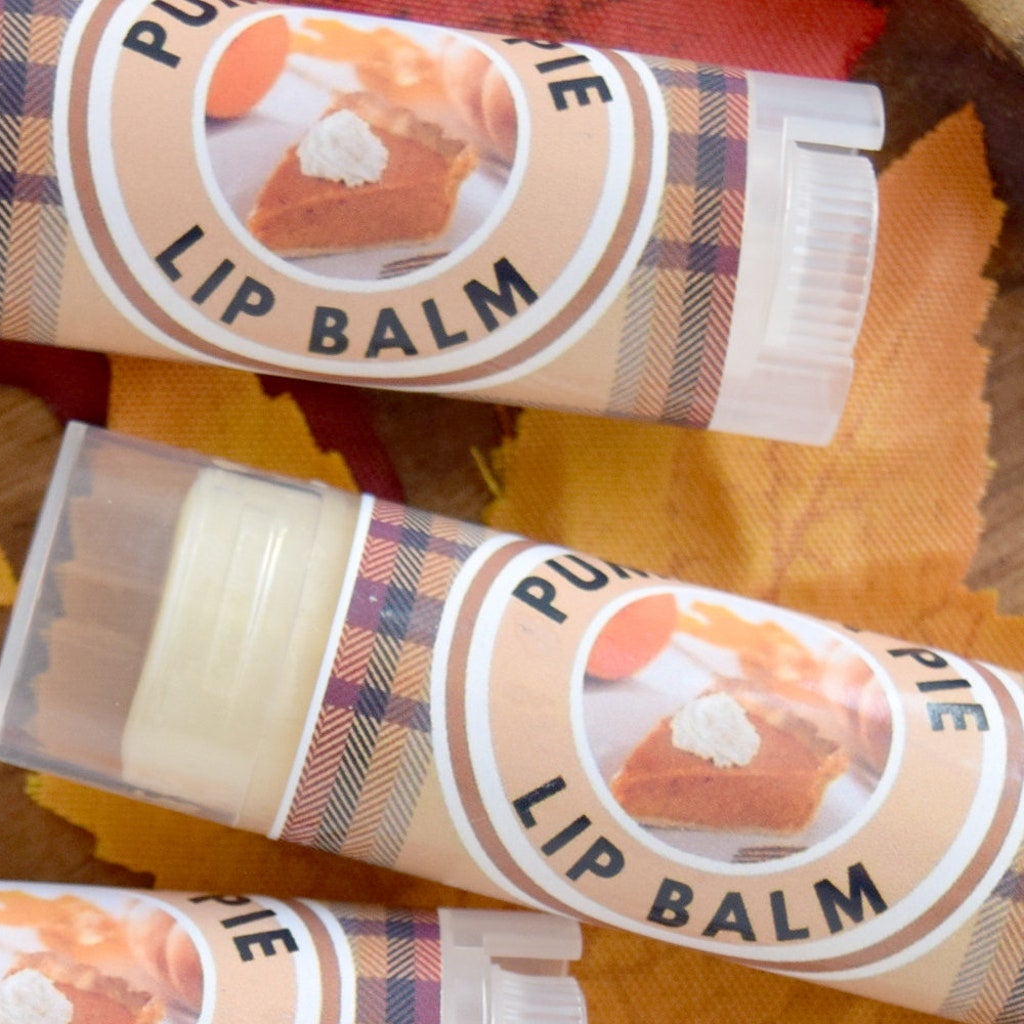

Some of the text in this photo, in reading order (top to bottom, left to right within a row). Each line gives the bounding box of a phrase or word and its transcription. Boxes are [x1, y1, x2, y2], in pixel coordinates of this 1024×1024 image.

[154, 224, 539, 359] LIP BALM
[887, 648, 990, 732] PIE
[512, 776, 888, 942] LIP BALM
